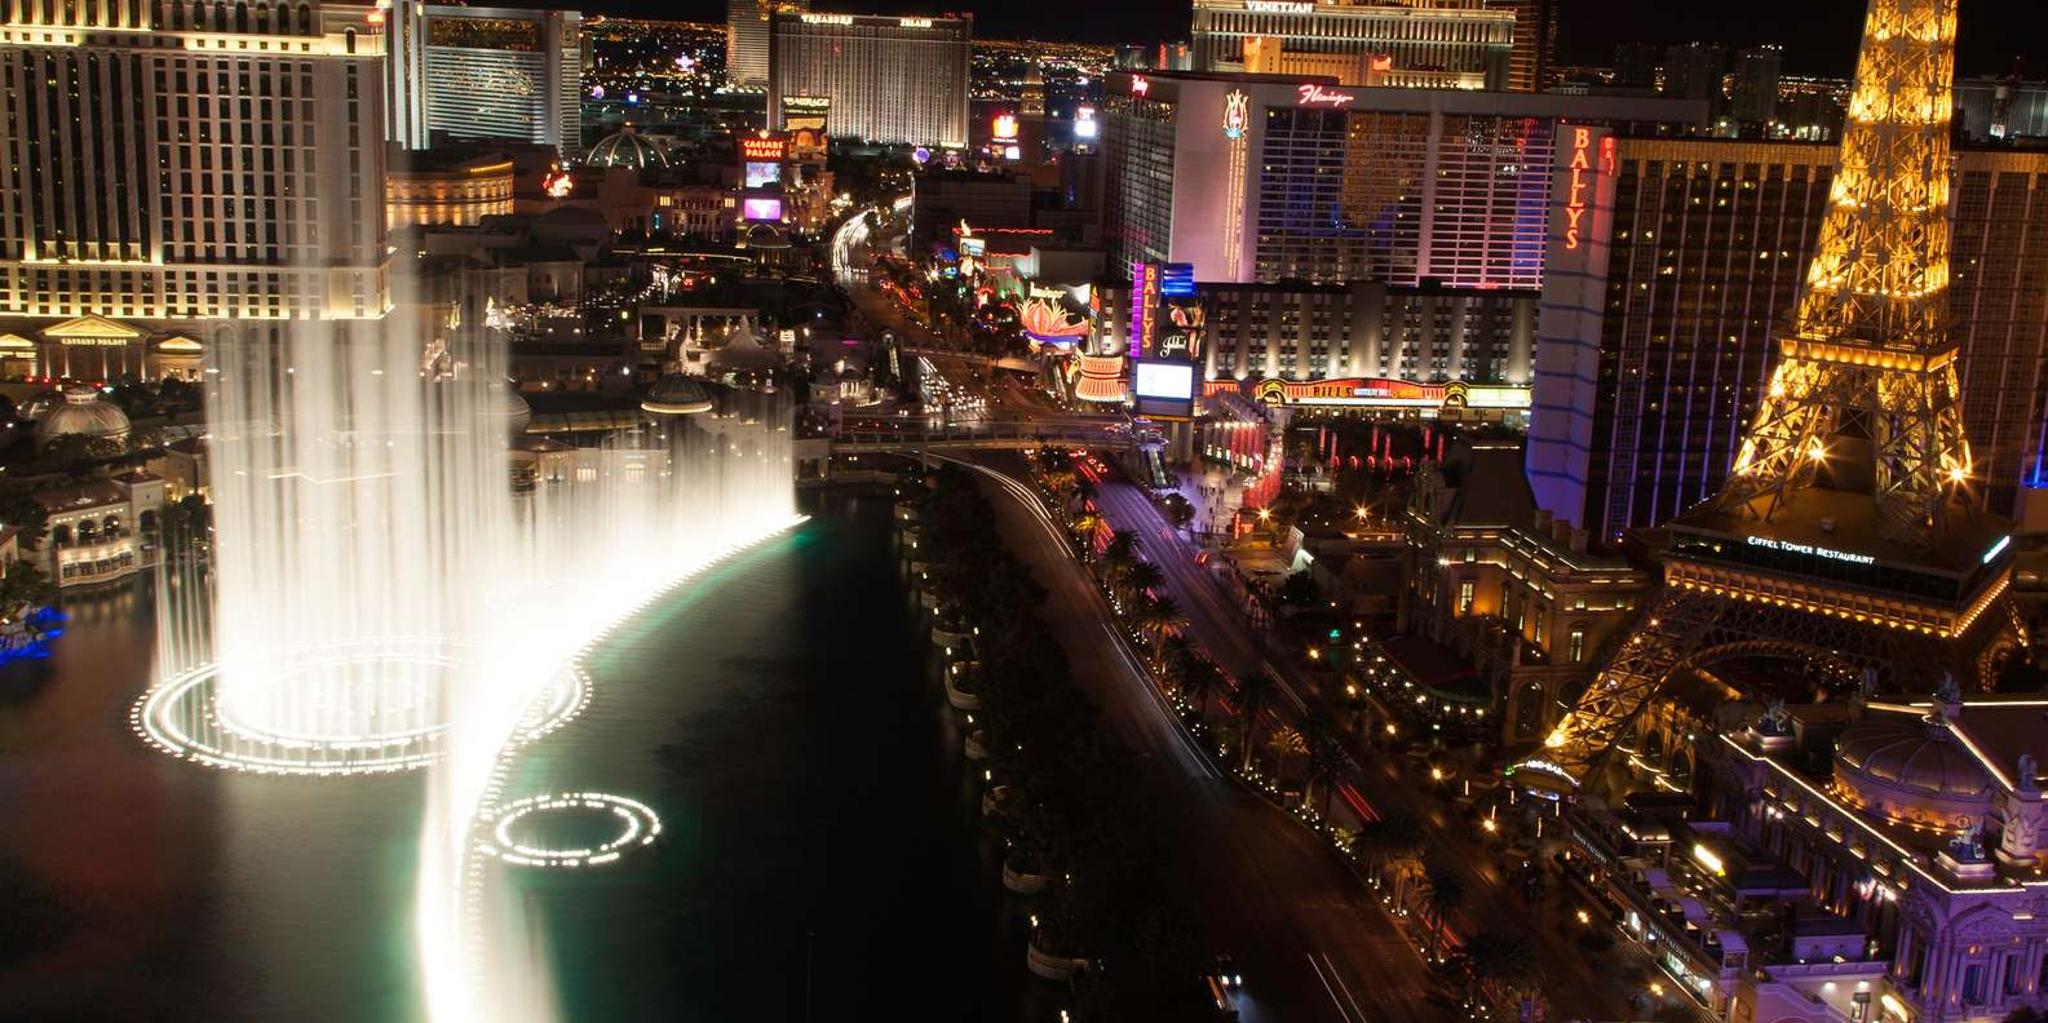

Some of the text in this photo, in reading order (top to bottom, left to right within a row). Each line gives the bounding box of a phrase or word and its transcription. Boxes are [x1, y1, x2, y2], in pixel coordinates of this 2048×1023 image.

[1247, 1, 1314, 13] VENETIAN
[801, 14, 932, 27] TREASURE ISLAND
[1298, 84, 1354, 106] Flamingo
[744, 141, 783, 149] CAESARS
[746, 149, 781, 157] PALACE
